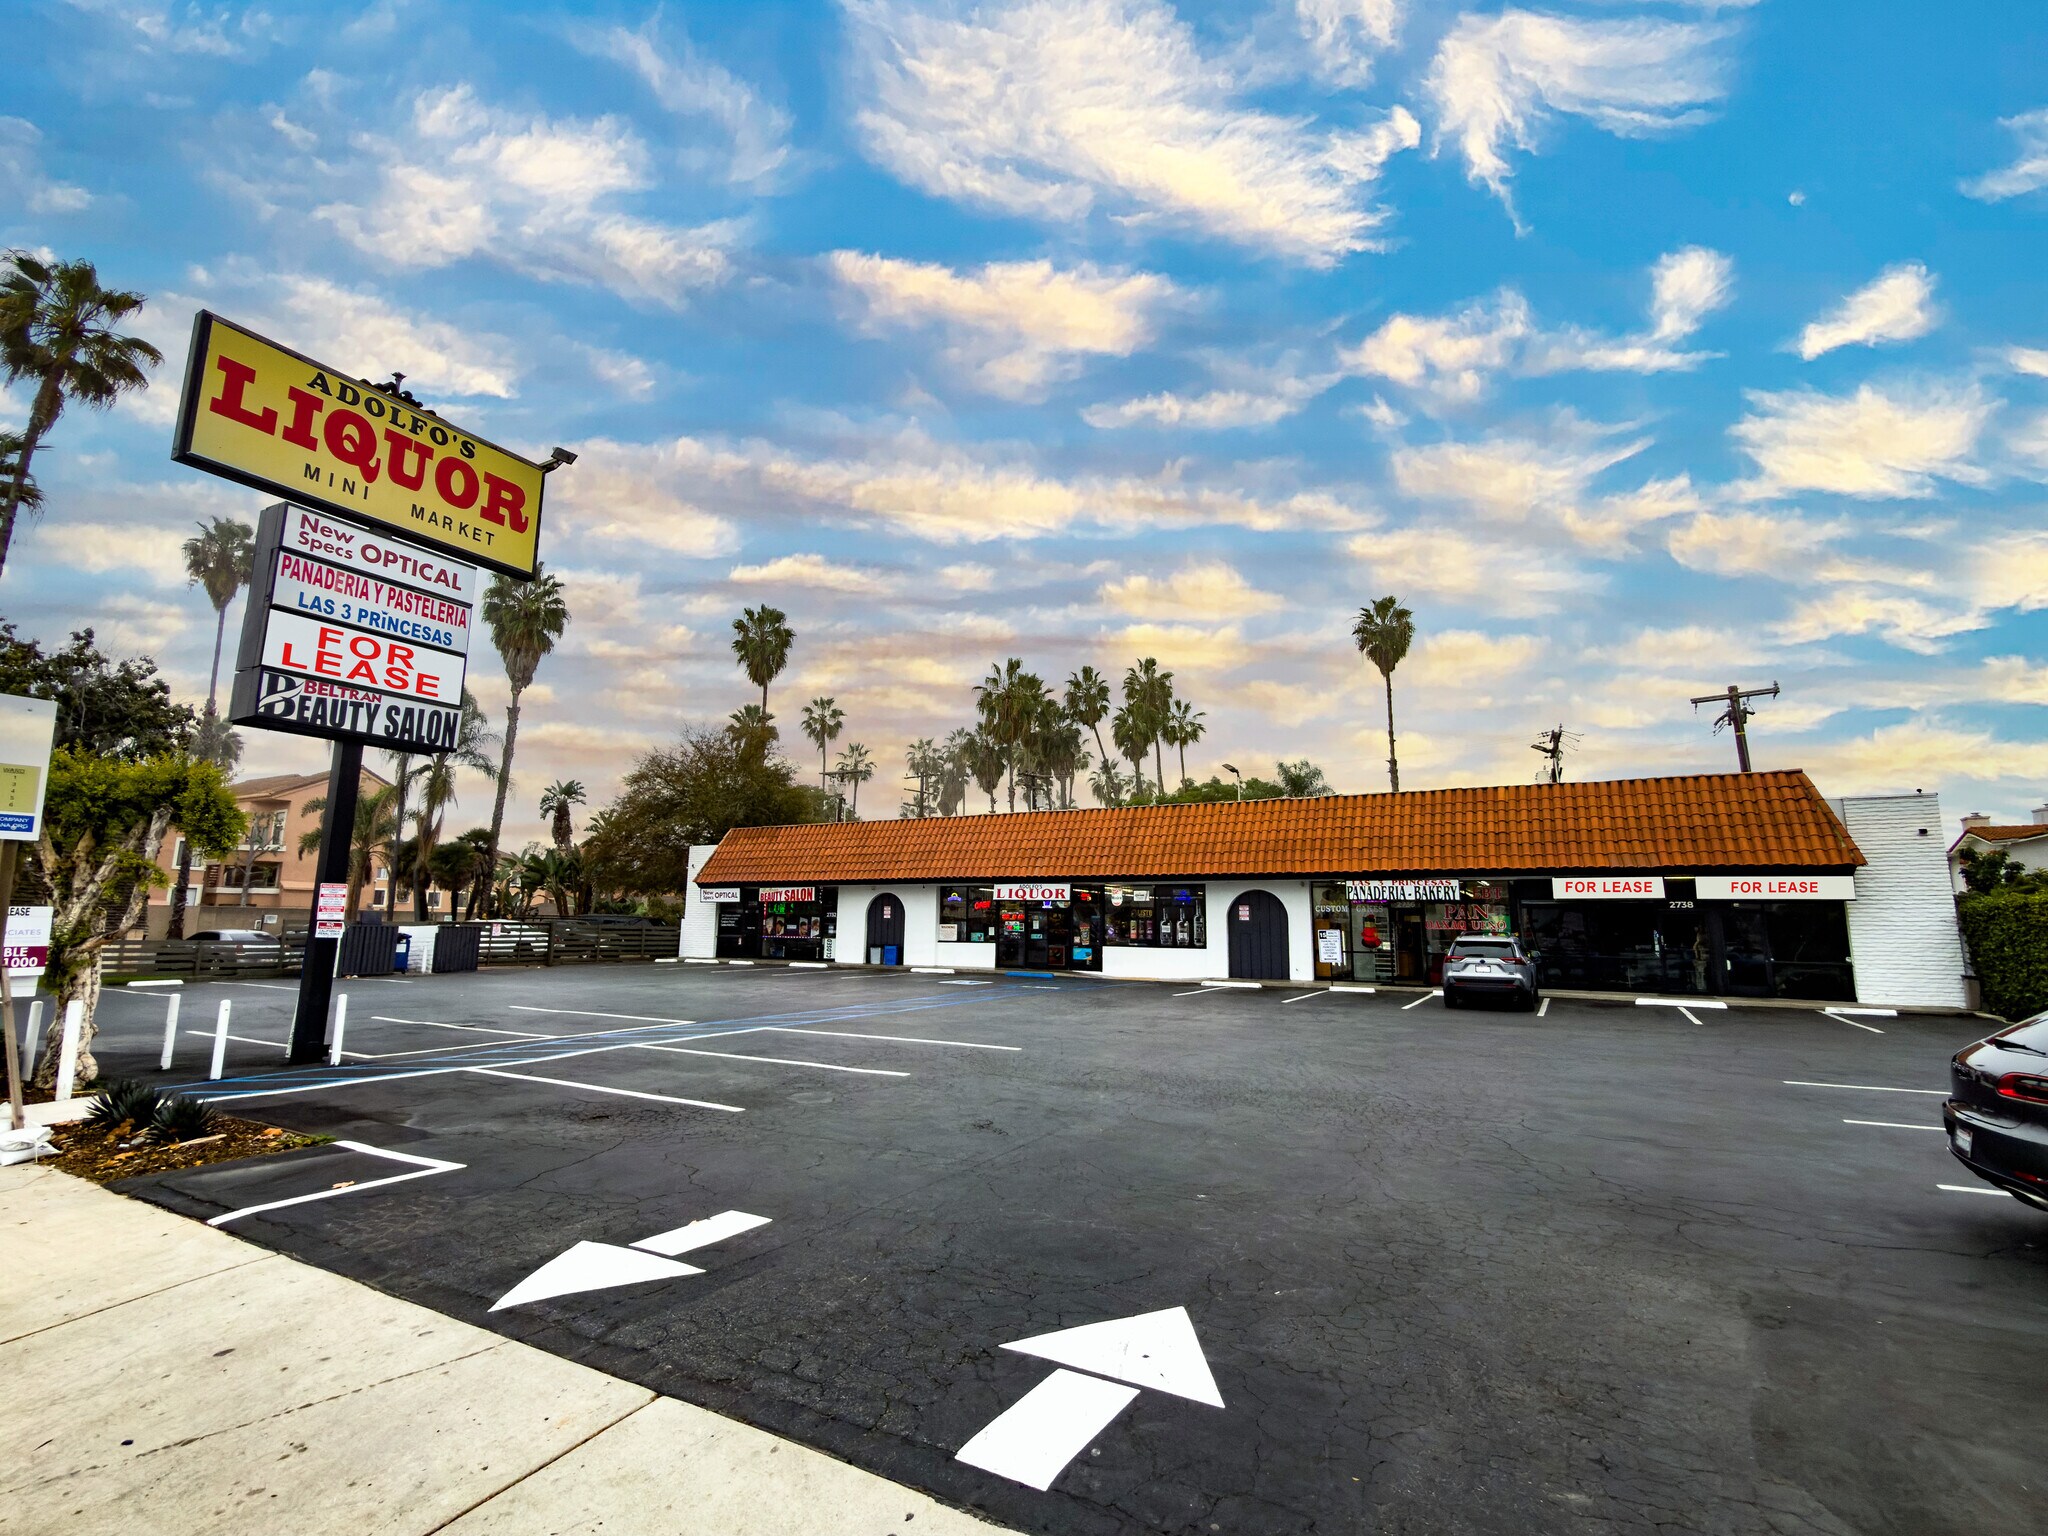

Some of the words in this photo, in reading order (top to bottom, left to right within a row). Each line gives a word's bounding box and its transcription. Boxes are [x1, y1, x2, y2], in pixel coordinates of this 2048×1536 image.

[306, 371, 476, 459] ADOLFO'S
[209, 354, 529, 534] LIQUOR
[303, 462, 369, 500] MINI
[410, 503, 495, 546] MARKET
[300, 513, 355, 544] New
[297, 531, 353, 560] Specs
[360, 543, 462, 592] OPTICAL
[280, 553, 369, 601] PANADERIA
[373, 581, 385, 604] Y
[386, 586, 467, 629] PASTELERIA
[297, 591, 336, 616] LAS
[340, 603, 352, 620] 3
[317, 626, 415, 670] FOR
[281, 642, 440, 698] LEASE
[303, 679, 383, 704] BELTRAN
[258, 671, 381, 736] BEAUTY
[384, 704, 460, 749] SALON
[714, 891, 738, 899] OPTICAL
[760, 891, 783, 901] BEAUTY
[784, 888, 814, 901] SALON
[996, 888, 1067, 900] LIQUOR
[1347, 885, 1406, 900] PANADERIA
[1414, 885, 1458, 900] BAKERY
[1564, 881, 1597, 893] FOR
[1602, 881, 1653, 893] LEASE
[1730, 881, 1763, 893] FOR
[1768, 881, 1819, 893] LEASE
[1315, 904, 1349, 913] CUSTOM
[1355, 904, 1384, 913] CAKES
[1443, 903, 1490, 920] PAN
[1668, 901, 1694, 909] 2738
